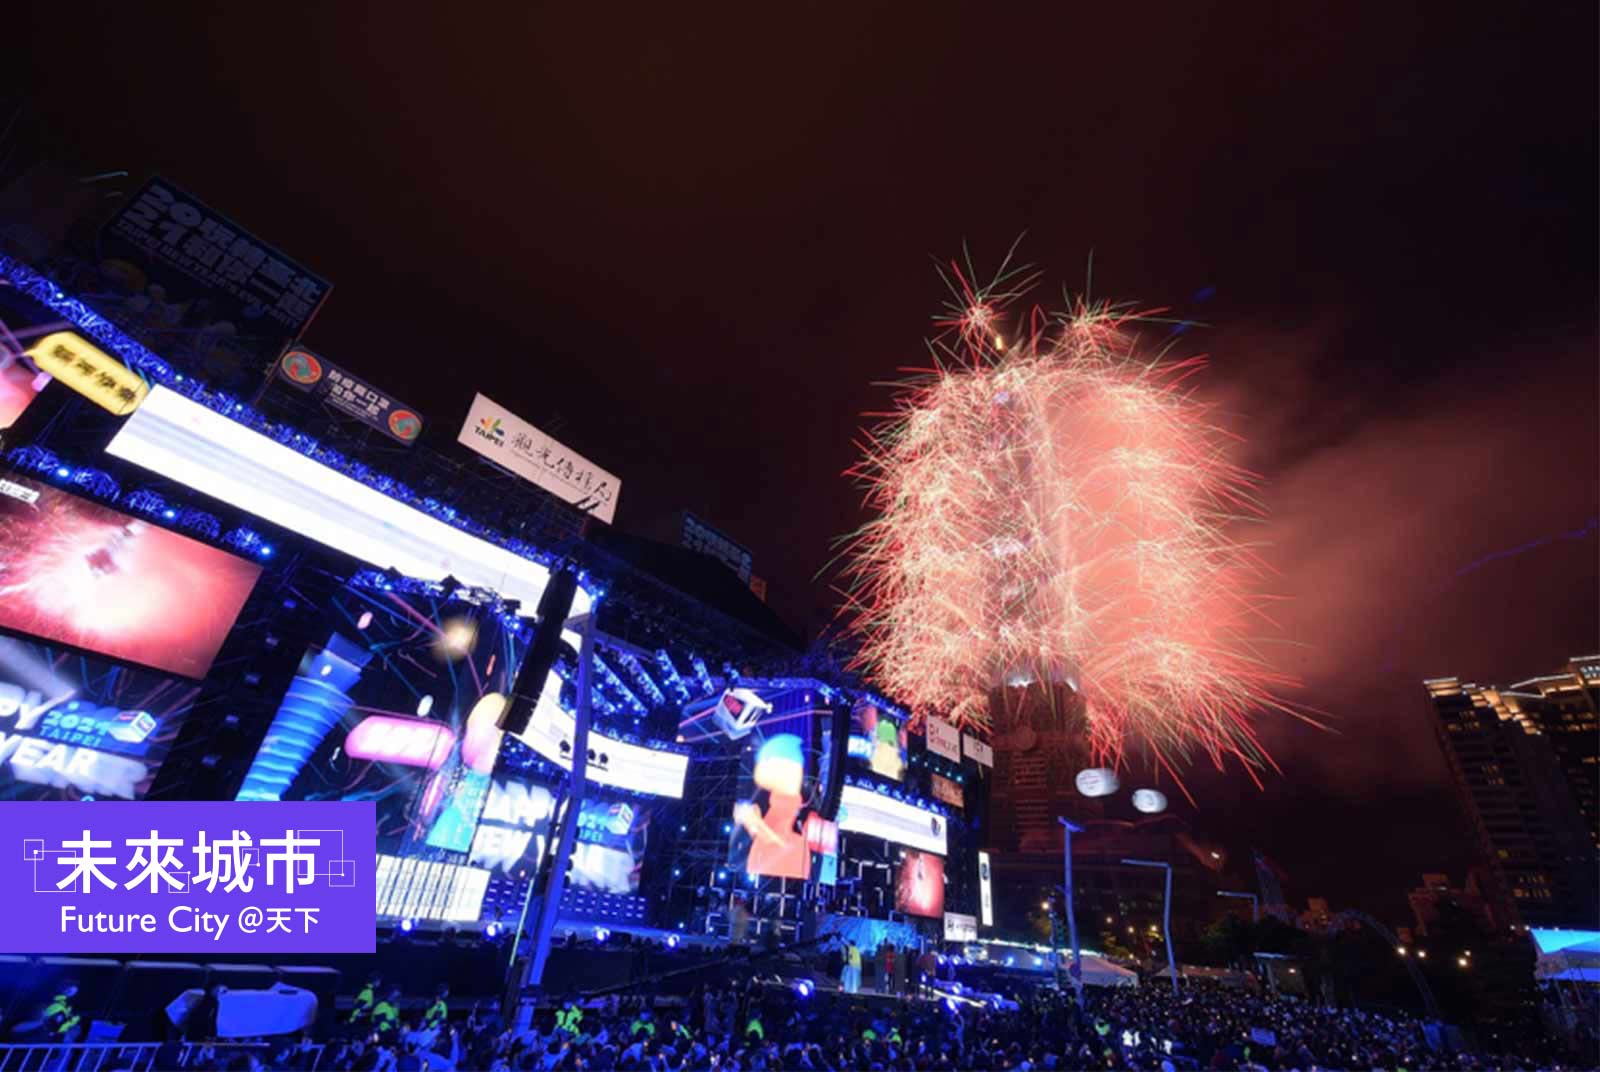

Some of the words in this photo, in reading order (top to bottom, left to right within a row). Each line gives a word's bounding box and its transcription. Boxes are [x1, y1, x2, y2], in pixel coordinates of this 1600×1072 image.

[474, 425, 505, 448] TAIPEI
[43, 710, 111, 737] 2021
[40, 726, 102, 747] TAIPEI
